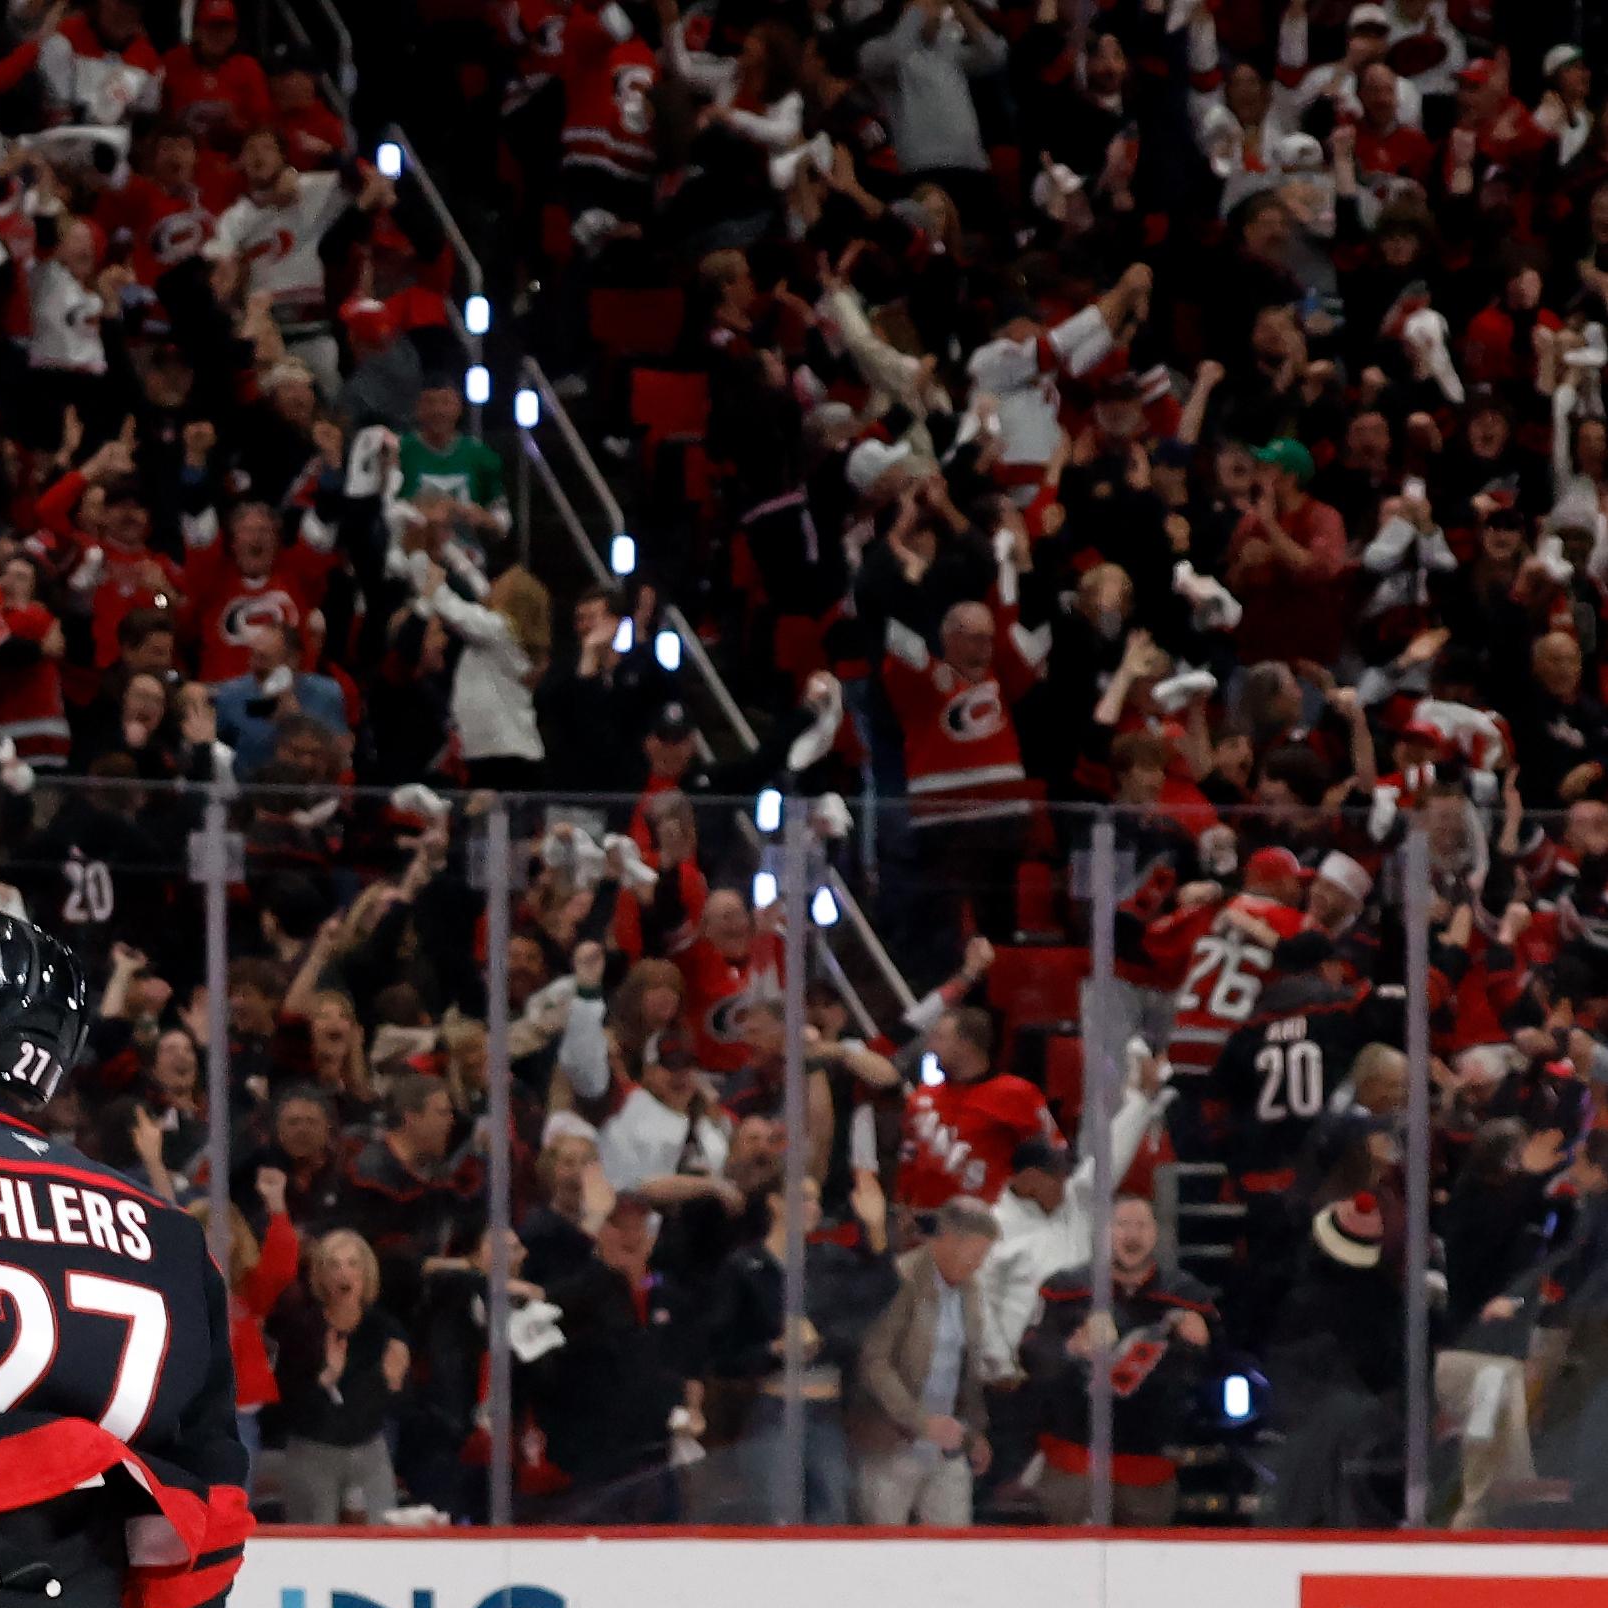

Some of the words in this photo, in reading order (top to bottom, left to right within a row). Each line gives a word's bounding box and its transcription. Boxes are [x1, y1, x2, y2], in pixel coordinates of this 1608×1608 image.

[1176, 932, 1274, 1021] 26
[12, 1041, 52, 1086] 27
[1255, 1039, 1324, 1122] 20
